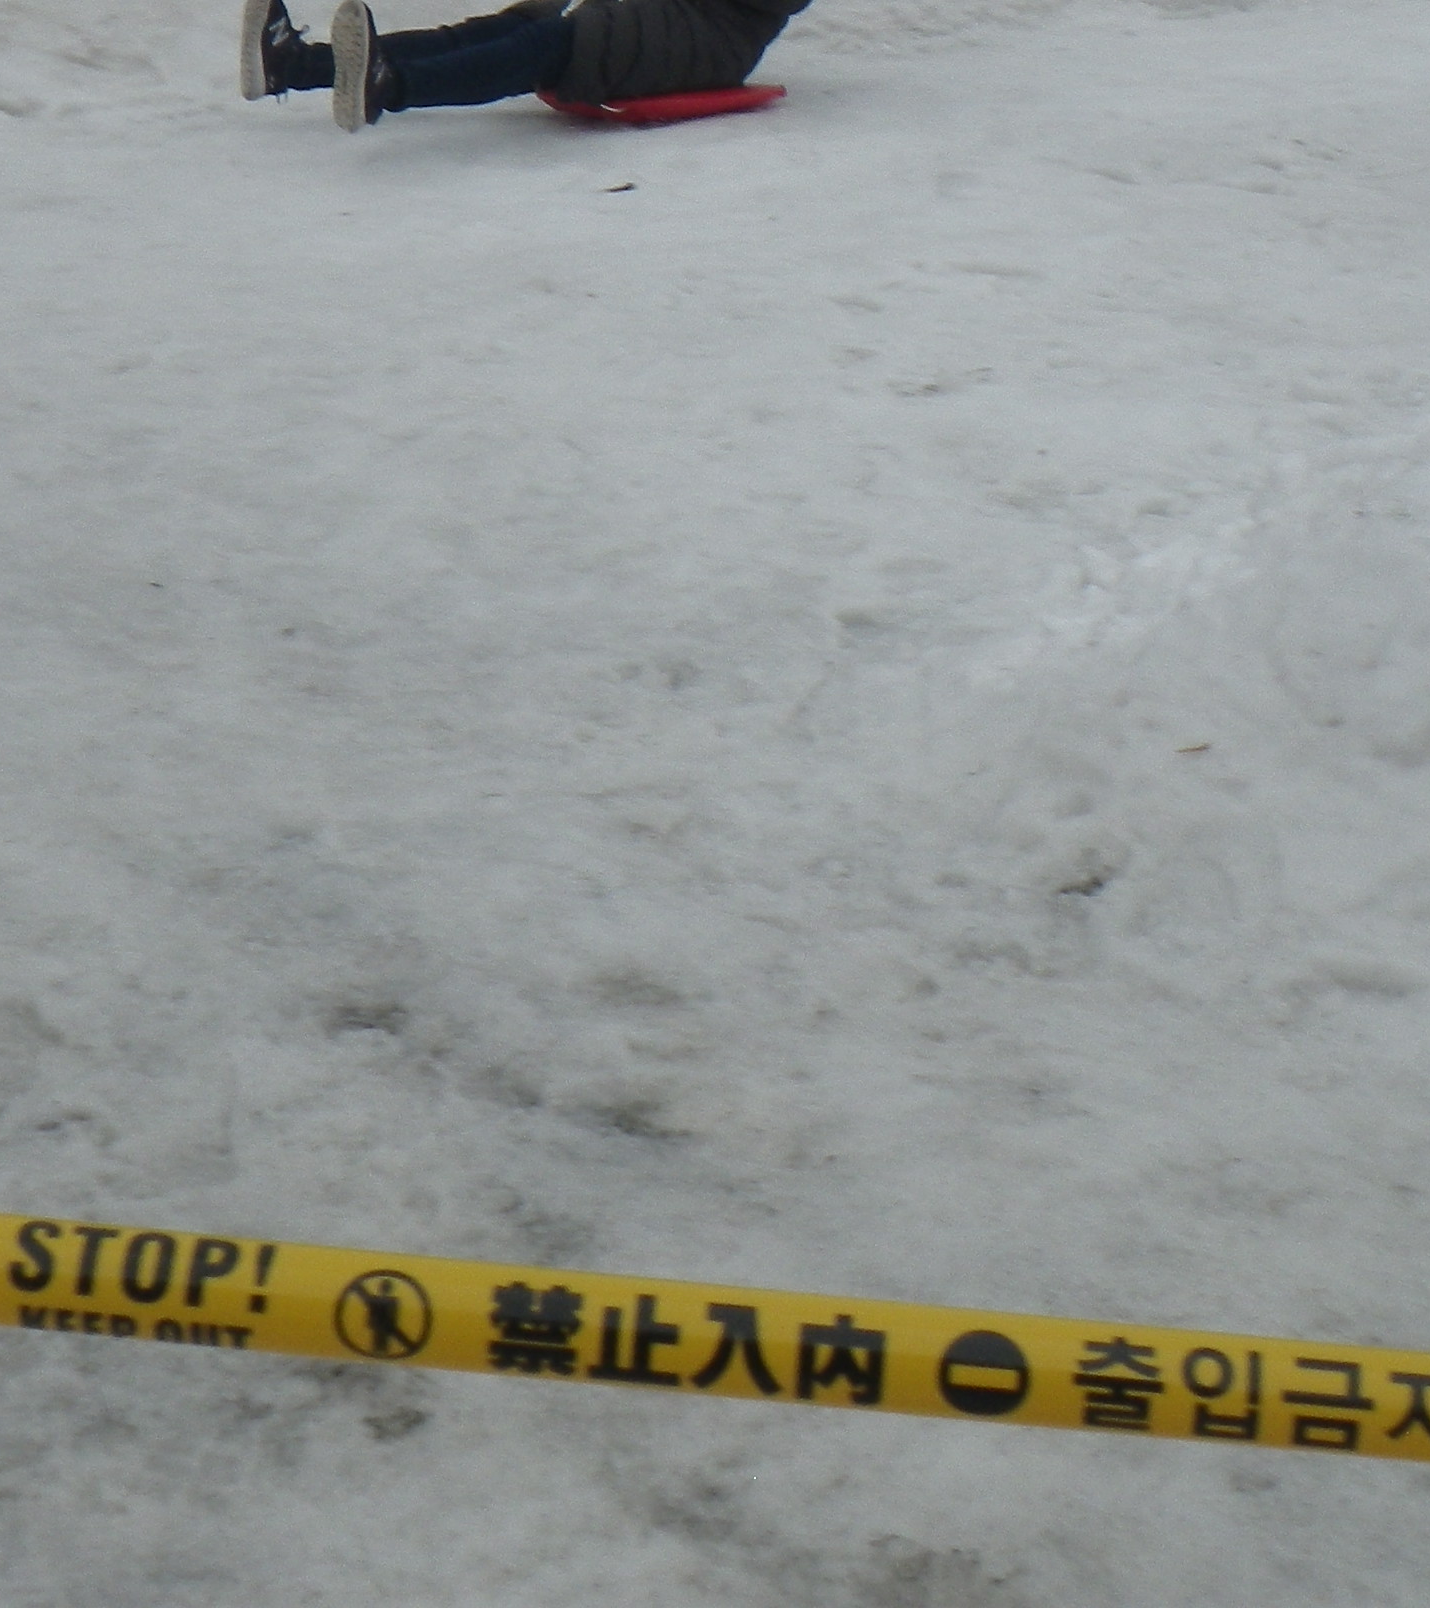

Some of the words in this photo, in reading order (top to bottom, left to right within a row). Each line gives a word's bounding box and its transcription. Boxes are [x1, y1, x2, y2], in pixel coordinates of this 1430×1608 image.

[8, 1220, 280, 1314] STOP!
[487, 1281, 886, 1406] 禁止入内
